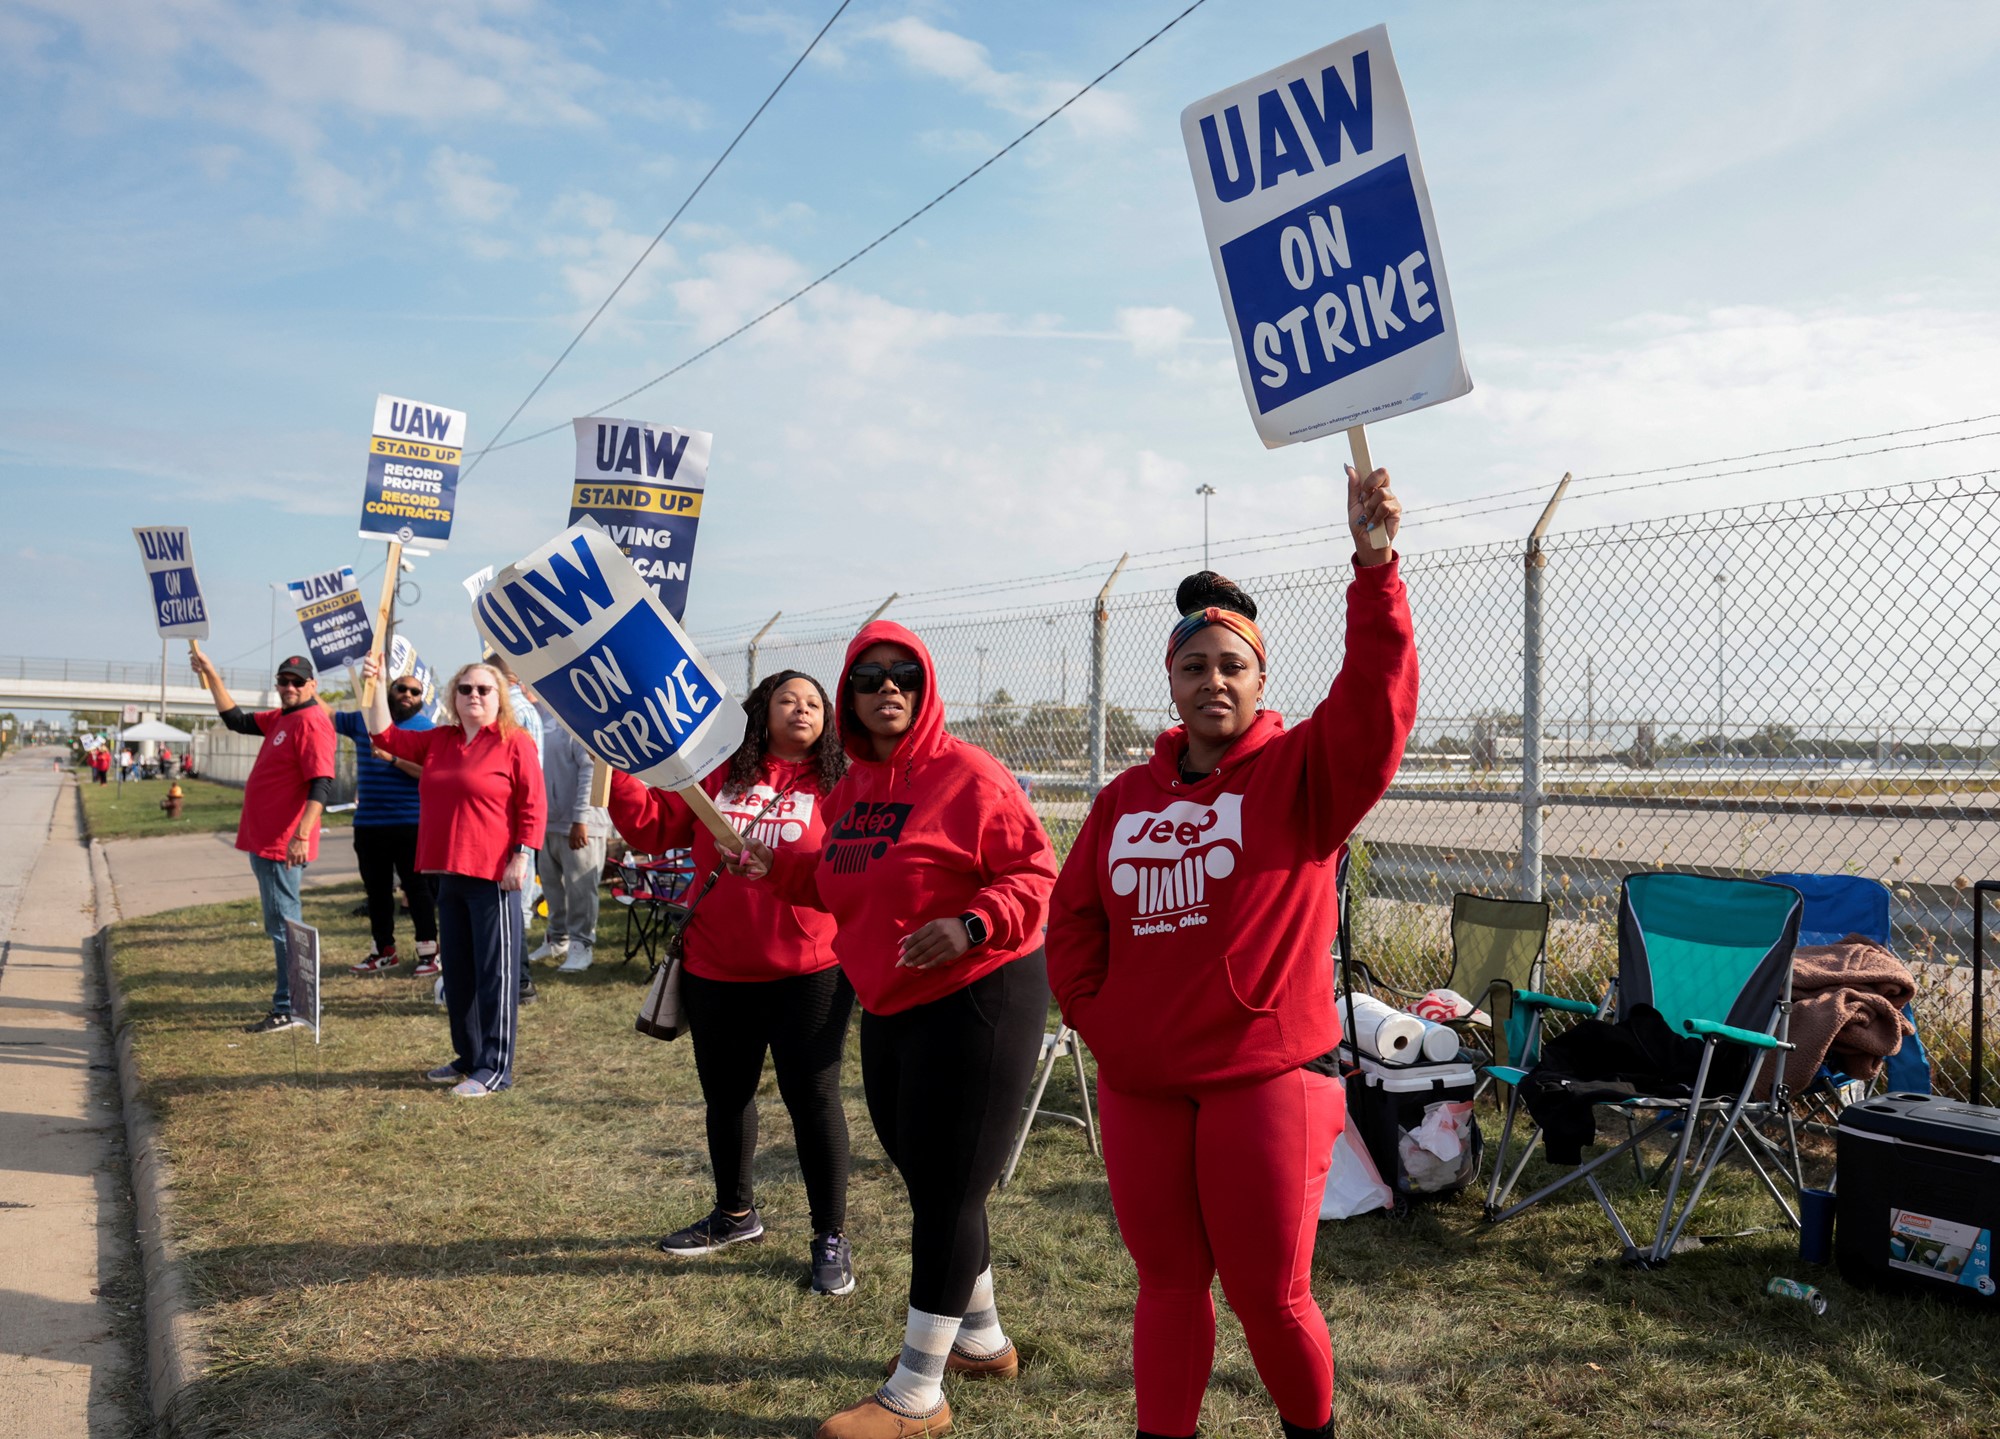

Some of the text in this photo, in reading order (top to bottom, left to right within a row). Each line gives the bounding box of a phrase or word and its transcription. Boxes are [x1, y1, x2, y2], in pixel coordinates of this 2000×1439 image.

[1199, 50, 1373, 203] UAW
[1280, 205, 1351, 290] ON
[1253, 250, 1435, 388] STRIKE
[390, 402, 452, 441] UAW
[1289, 427, 1308, 436] American
[1308, 421, 1327, 431] Graphics
[376, 441, 456, 461] STAND UP
[596, 424, 690, 480] UAW
[384, 462, 443, 481] RECORD
[383, 476, 442, 494] PROFITS
[381, 490, 440, 507] RECORD
[578, 487, 694, 512] STAND UP
[366, 501, 451, 522] CONTRACTS
[139, 532, 184, 561] UAW
[601, 525, 671, 549] AVING
[619, 547, 631, 555] HE
[165, 571, 181, 596] ON
[301, 571, 344, 601] UAW
[477, 535, 615, 656] UAW
[161, 596, 203, 624] STRIKE
[301, 593, 357, 619] STAND UP
[310, 620, 369, 649] AMERICAN
[313, 611, 356, 633] SAVING
[321, 633, 363, 655] DREAM
[569, 645, 632, 713] ON
[593, 659, 708, 770] STRIKE
[841, 807, 897, 834] Jeep
[1127, 809, 1218, 846] Jeep
[1132, 912, 1208, 936] Toledo, Ohio
[1976, 1243, 1987, 1252] 50
[1974, 1258, 1986, 1267] 84
[1979, 1280, 1986, 1290] 5
